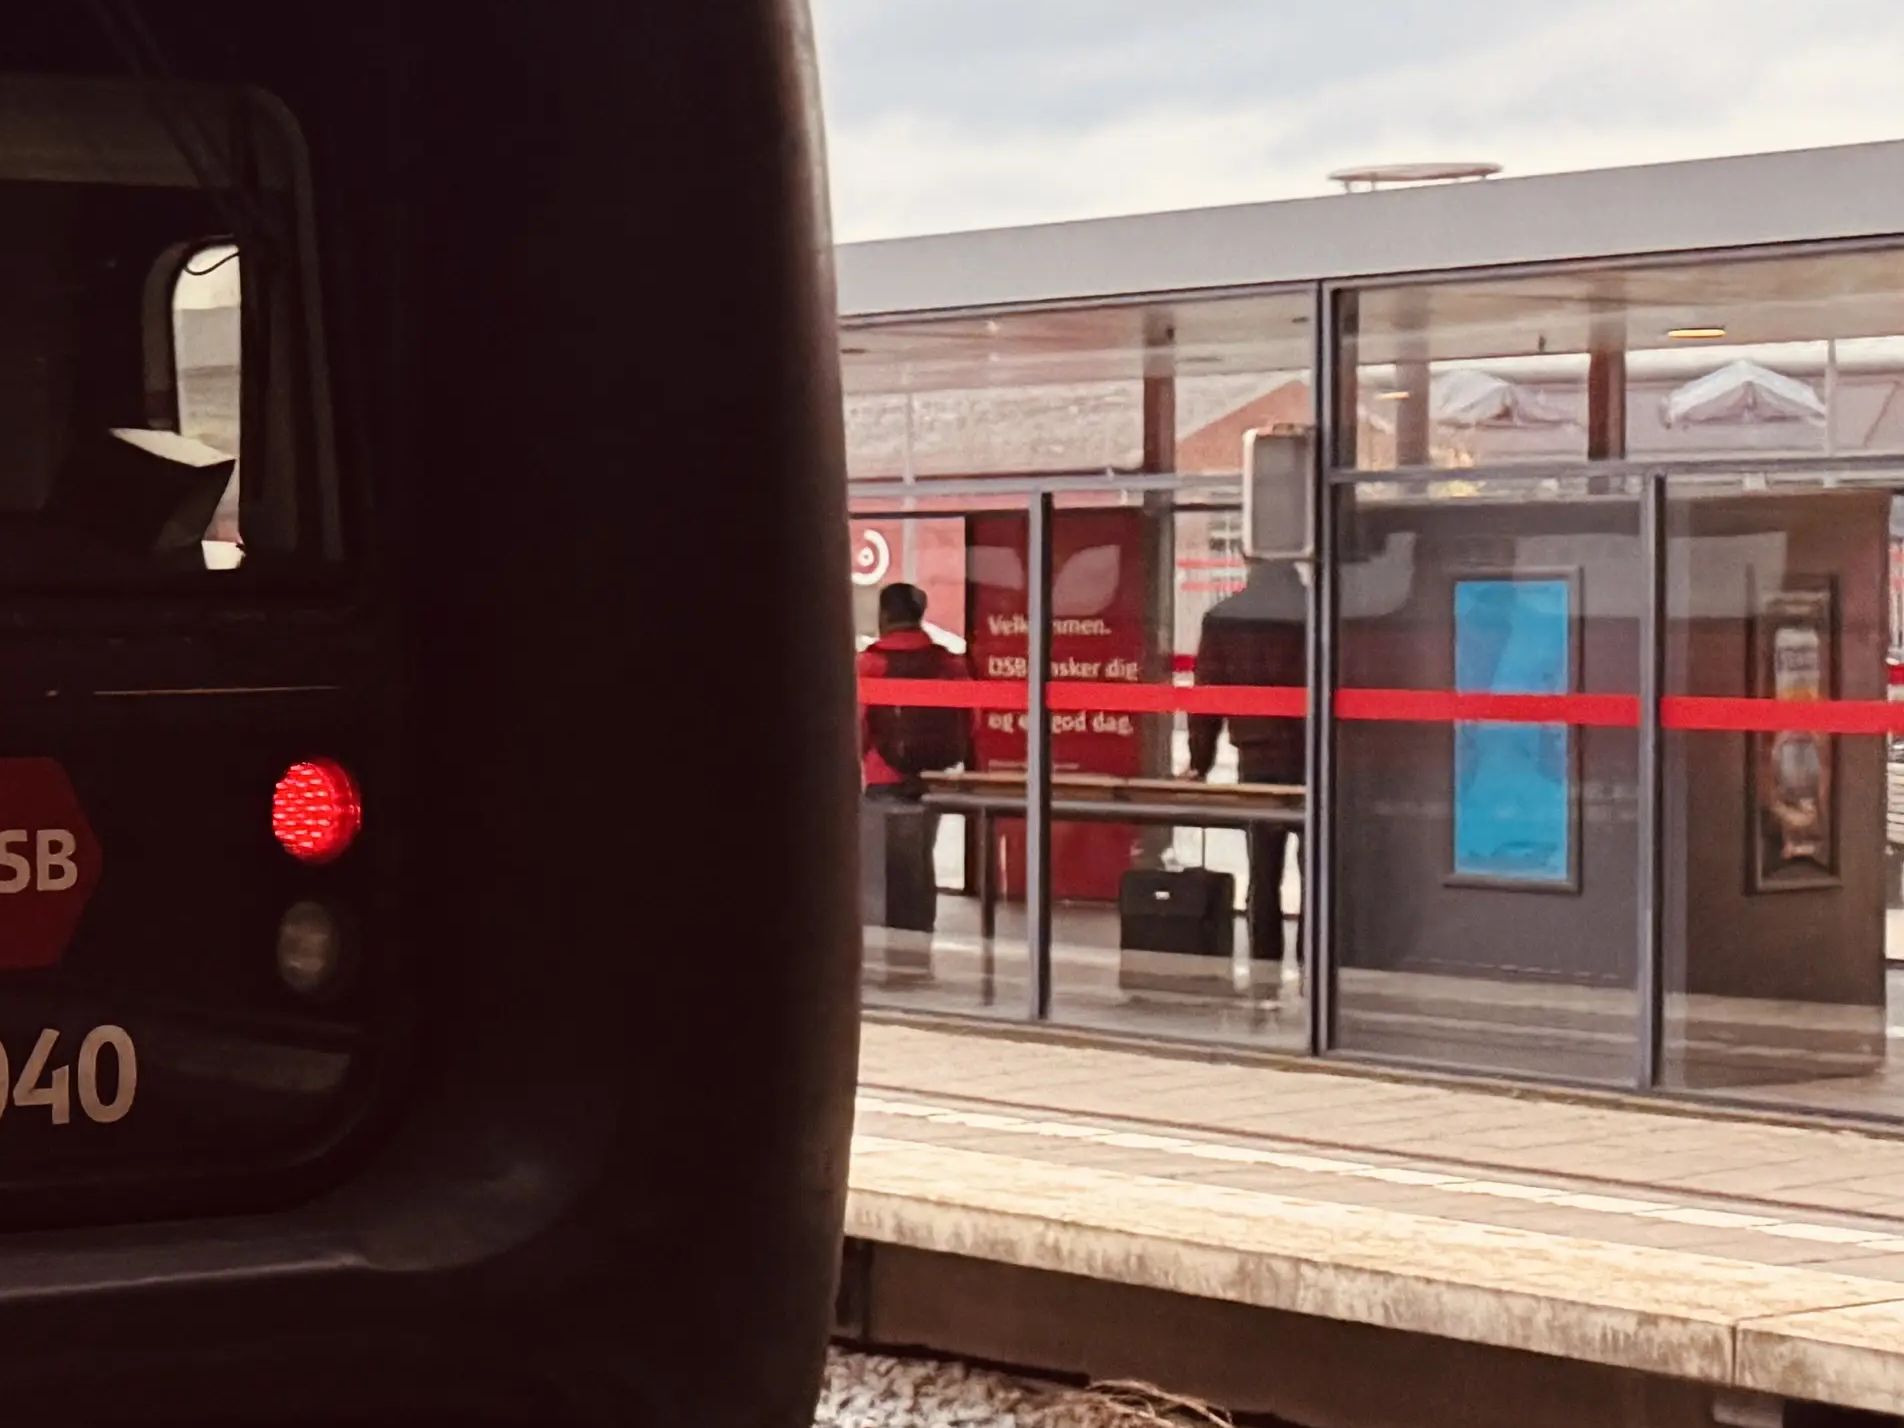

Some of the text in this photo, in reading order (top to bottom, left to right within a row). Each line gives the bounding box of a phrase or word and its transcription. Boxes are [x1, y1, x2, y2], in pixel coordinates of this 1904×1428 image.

[988, 656, 1138, 682] DSB nsker dig
